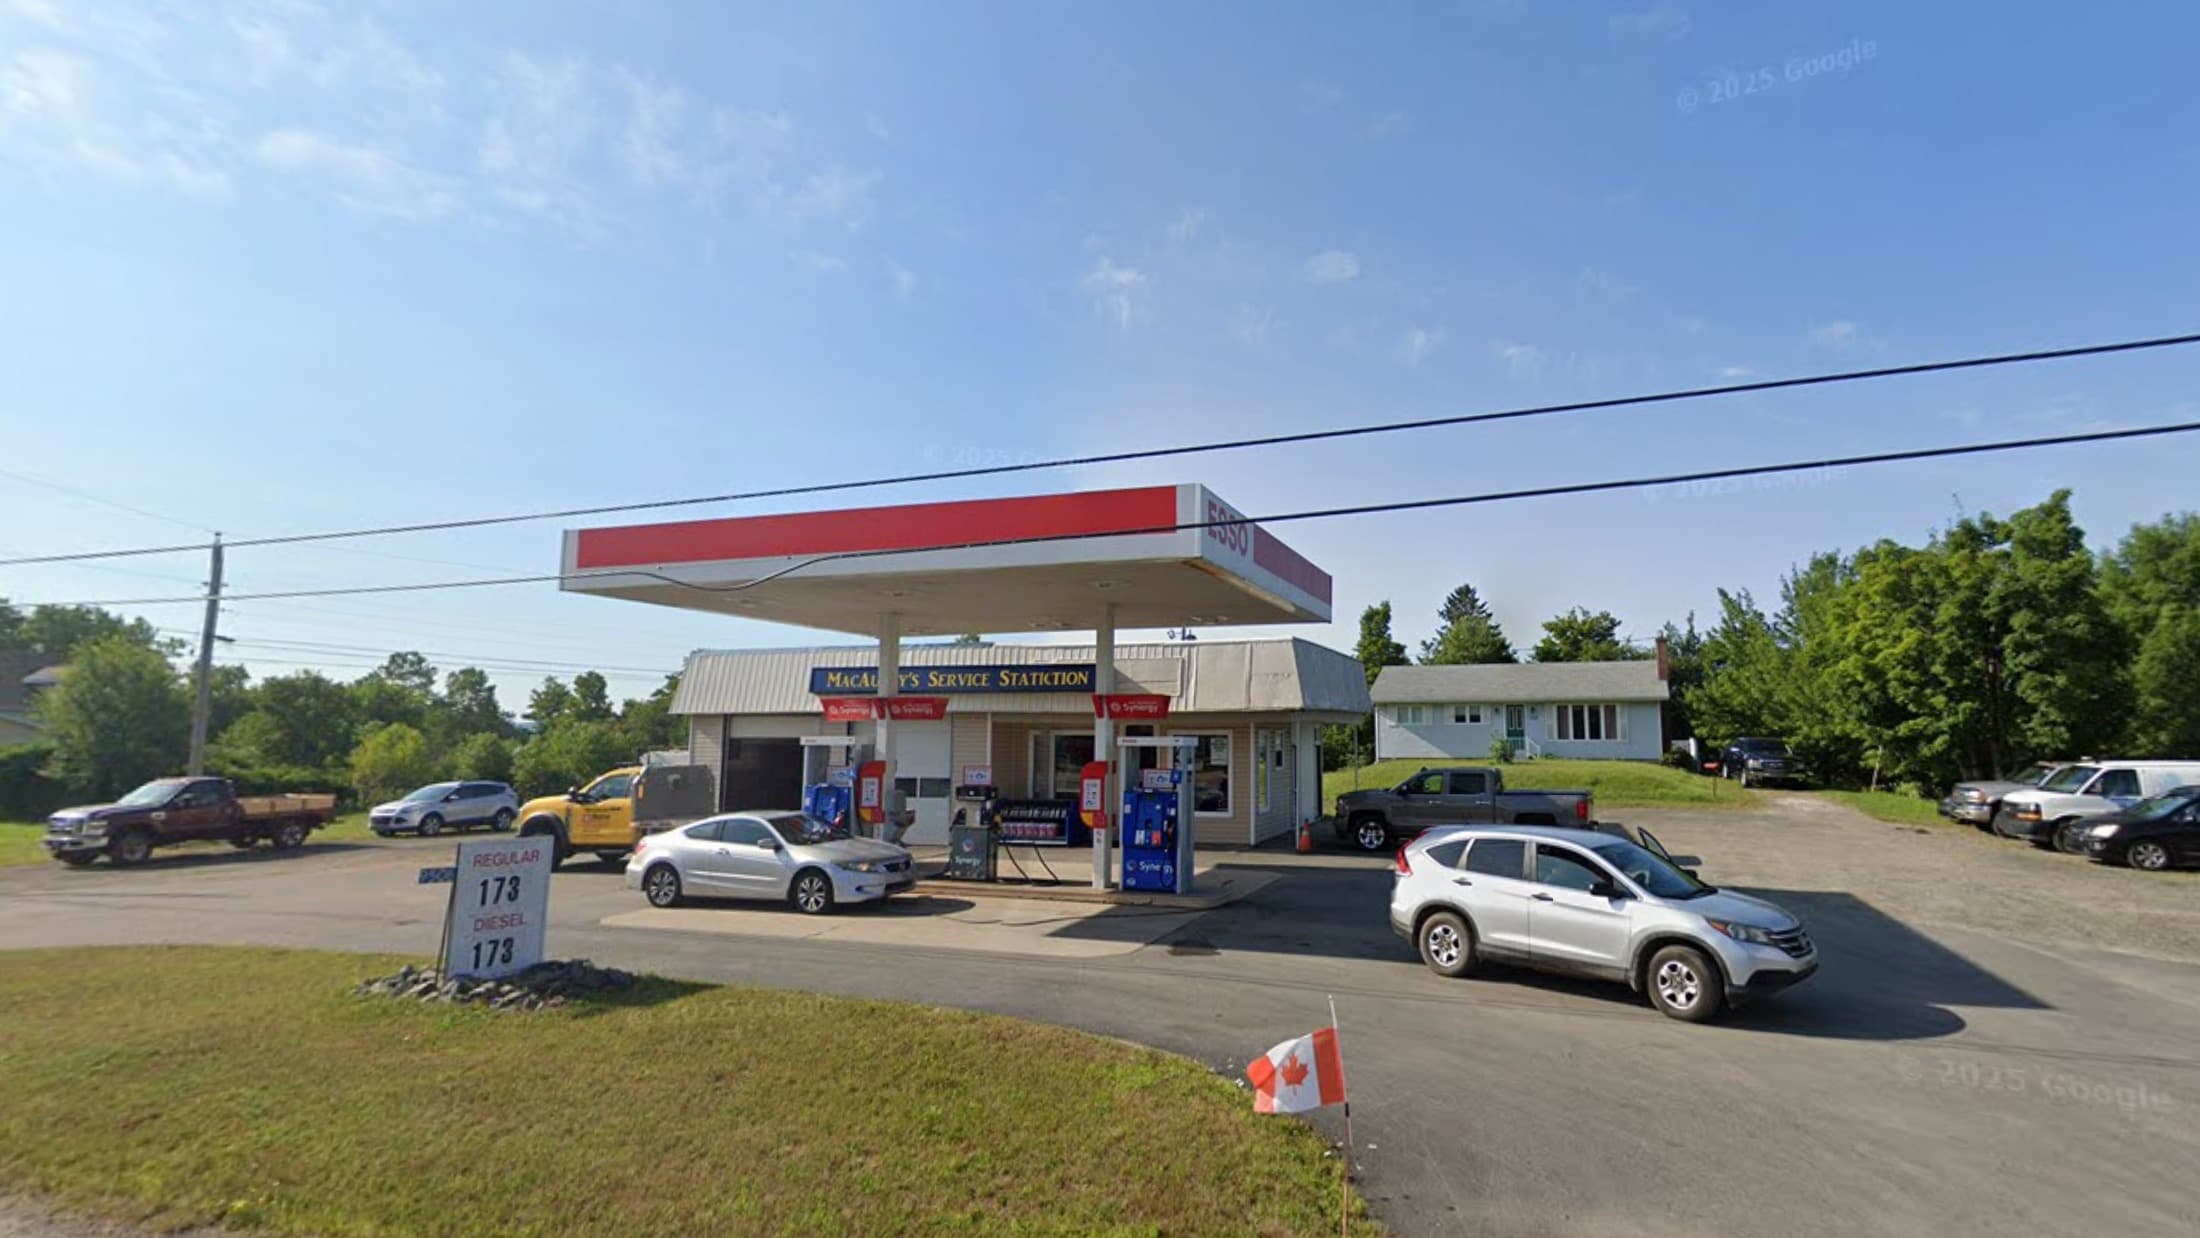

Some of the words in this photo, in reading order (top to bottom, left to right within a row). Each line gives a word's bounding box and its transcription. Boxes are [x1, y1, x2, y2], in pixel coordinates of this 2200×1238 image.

[1207, 499, 1248, 557] ESSO
[927, 669, 991, 687] SERVICE
[1122, 703, 1158, 713] Synergy
[473, 850, 540, 867] REGULAR
[1139, 861, 1175, 873] Synegy
[480, 876, 520, 906] 173
[473, 912, 527, 932] DIESEL
[473, 937, 514, 970] 173
